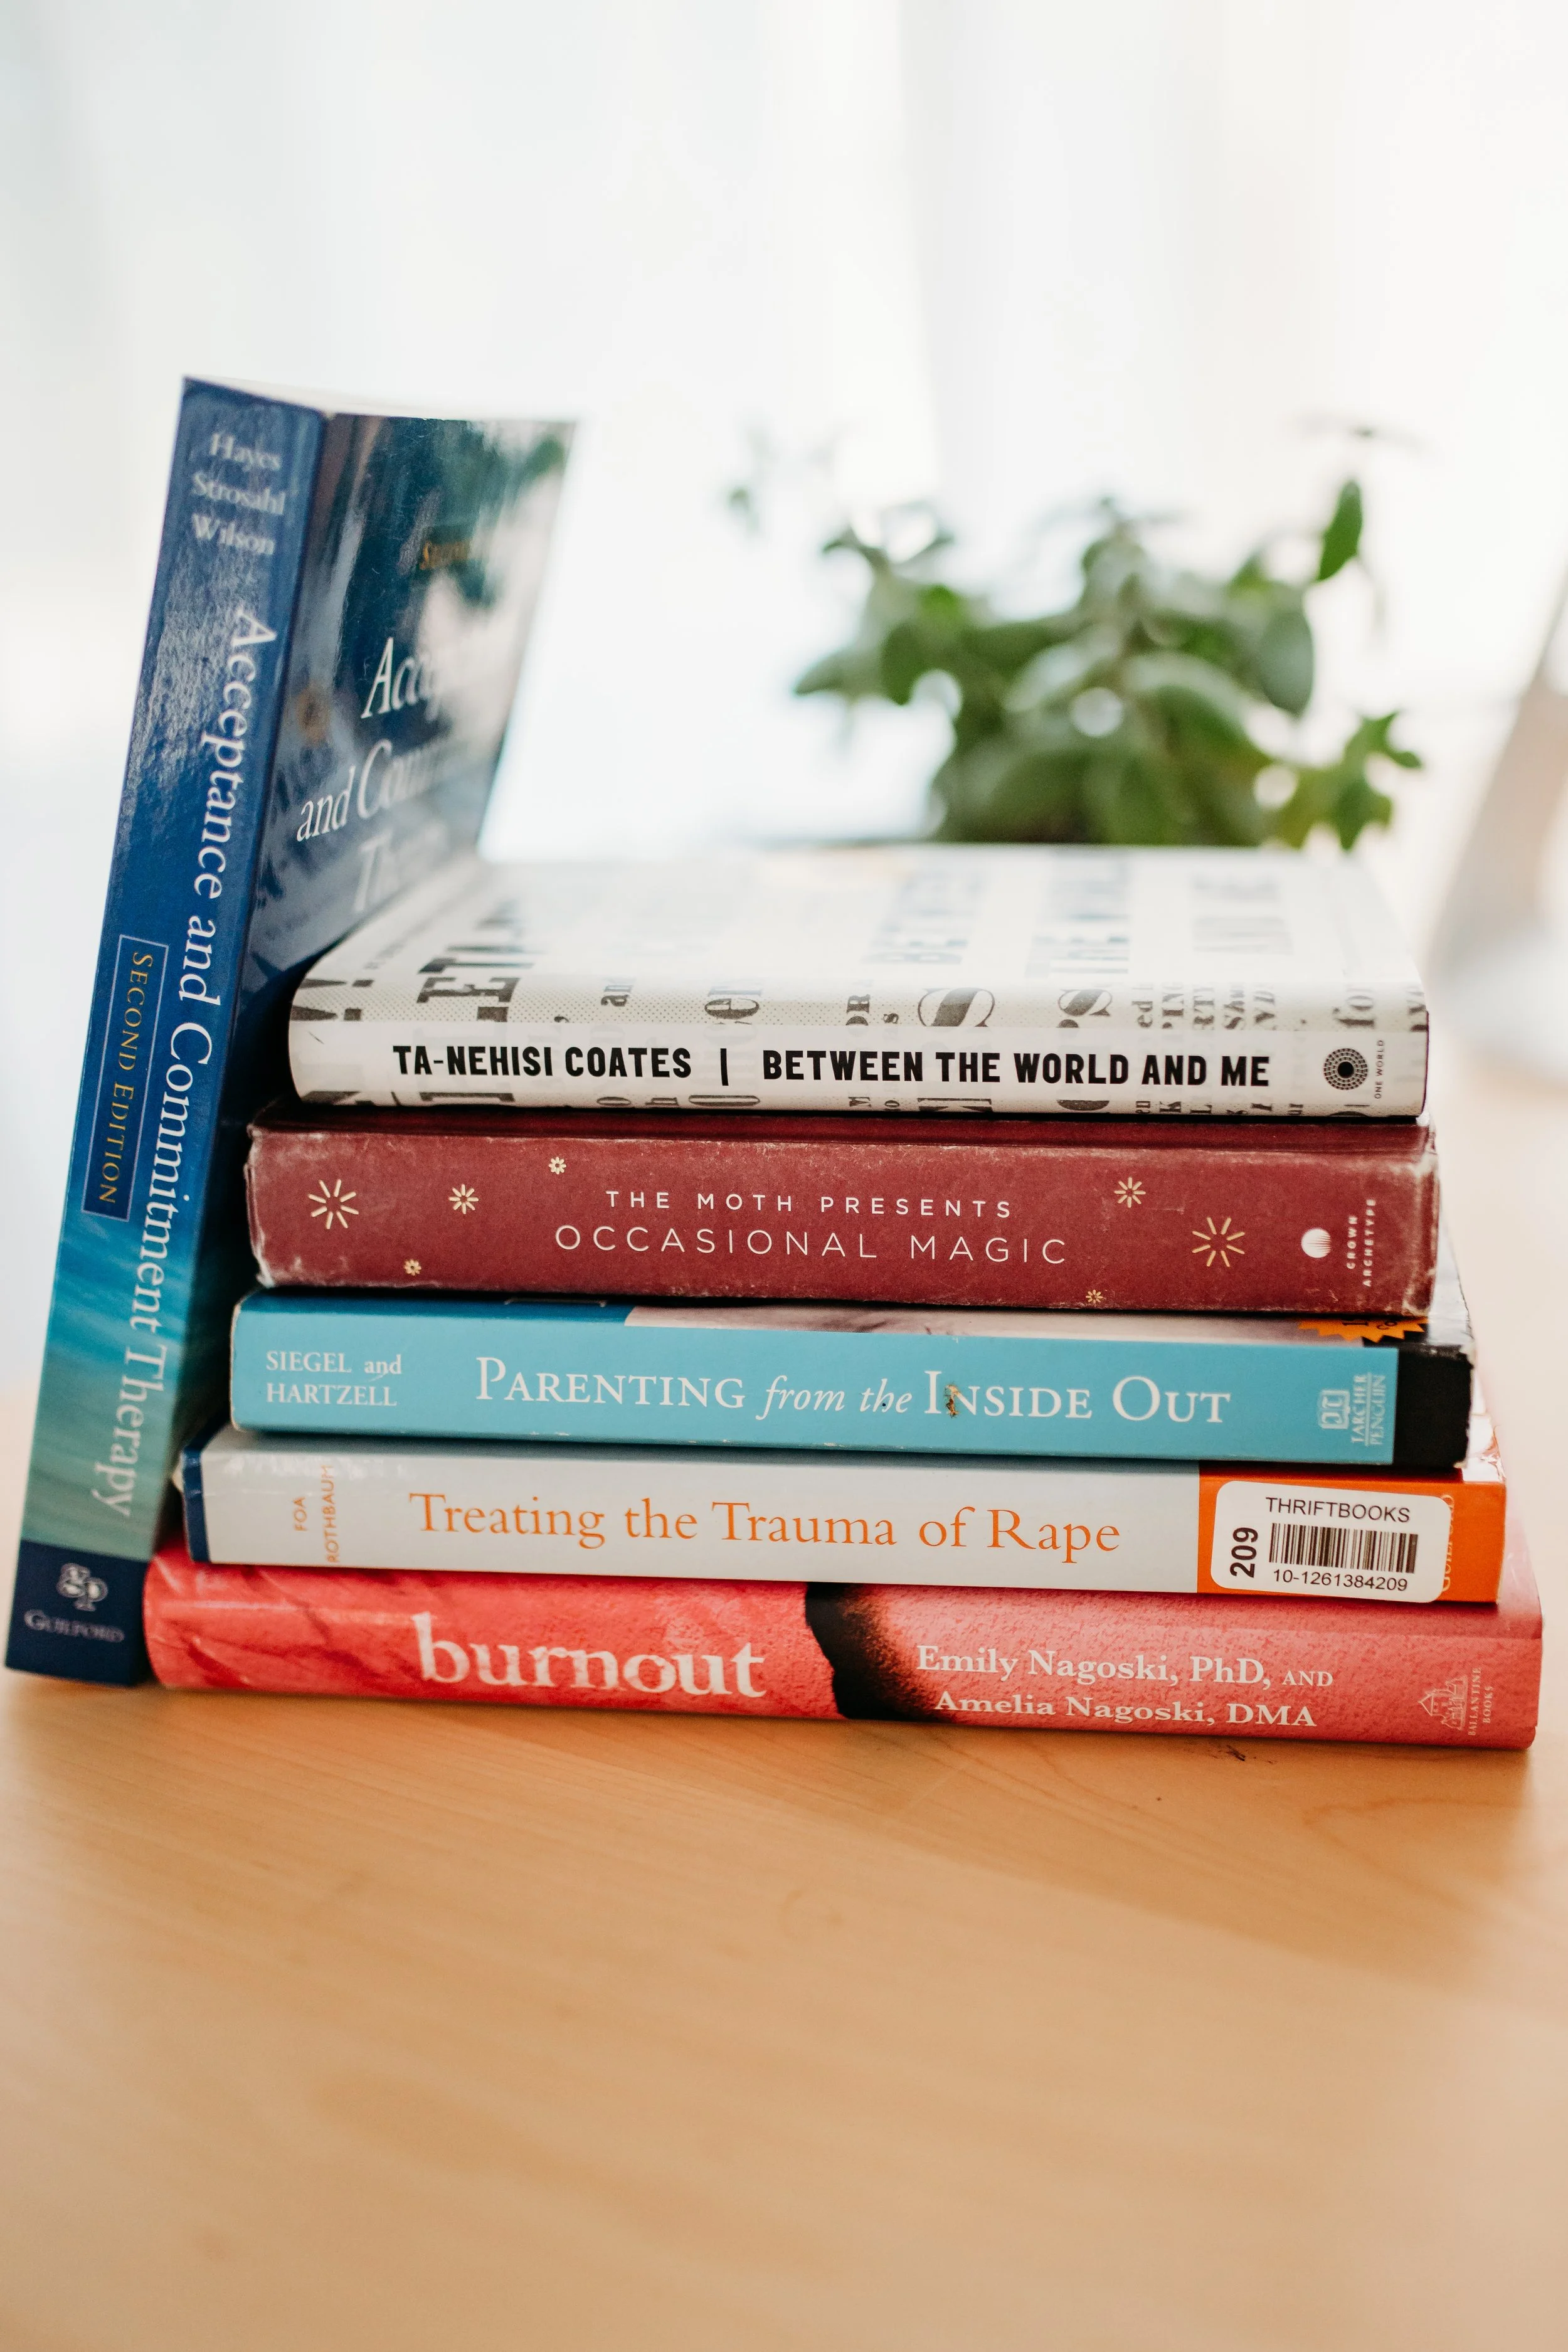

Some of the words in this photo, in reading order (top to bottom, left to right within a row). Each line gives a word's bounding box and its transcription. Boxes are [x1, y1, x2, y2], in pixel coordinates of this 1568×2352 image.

[209, 433, 281, 472] Hayes
[191, 513, 275, 556] Wilson
[194, 607, 277, 899] Acceptance
[179, 914, 221, 1006] and
[117, 951, 154, 1072] SECOND
[393, 1045, 553, 1077] TA-NEHISI
[564, 1046, 692, 1079] COATES
[763, 1049, 923, 1082] BETWEEN
[935, 1052, 1001, 1083] THE
[1014, 1053, 1129, 1085] WORLD
[1141, 1055, 1207, 1086] AND
[1221, 1056, 1270, 1087] ME
[1375, 1039, 1385, 1077] WORLD
[1374, 1079, 1384, 1099] ONE
[99, 1081, 135, 1204] EDITION
[129, 1022, 213, 1333] Commitment
[606, 1190, 670, 1210] THE
[697, 1193, 792, 1212] MOTH
[821, 1197, 1010, 1219] PRESENTS
[555, 1224, 877, 1259] OCCASIONAL
[911, 1234, 1066, 1264] MAGIC
[1347, 1215, 1359, 1270] CROWN
[1363, 1198, 1377, 1288] ARCHETYPE
[265, 1351, 351, 1374] SIEGEL
[364, 1353, 402, 1375] and
[266, 1382, 397, 1406] HARTZELL
[475, 1356, 744, 1409] PARENTING
[755, 1375, 844, 1420] from
[859, 1379, 913, 1413] the
[924, 1370, 1093, 1419] INSIDE
[1113, 1375, 1231, 1423] OUT
[91, 1343, 167, 1517] Therapy
[293, 1496, 306, 1532] FOA
[320, 1465, 339, 1564] ROTHBAUM
[410, 1492, 605, 1549] Treating
[625, 1498, 698, 1539] the
[711, 1502, 897, 1546] Trauma
[919, 1507, 975, 1547] of
[987, 1508, 1121, 1564] Rape
[1266, 1497, 1411, 1523] THRIFTBOOKS
[1229, 1527, 1258, 1578] 209
[1273, 1569, 1408, 1592] 10-1261384209
[411, 1612, 766, 1697] burnout
[916, 1645, 1017, 1682] Emily
[1029, 1650, 1179, 1685] Nagoski,
[1190, 1656, 1271, 1689] PhD,
[1282, 1671, 1333, 1687] AND
[935, 1692, 1056, 1715] Amelia
[1067, 1697, 1215, 1725] Nagoski,
[1227, 1704, 1317, 1727] DMA
[1482, 1685, 1493, 1724] BOOKS
